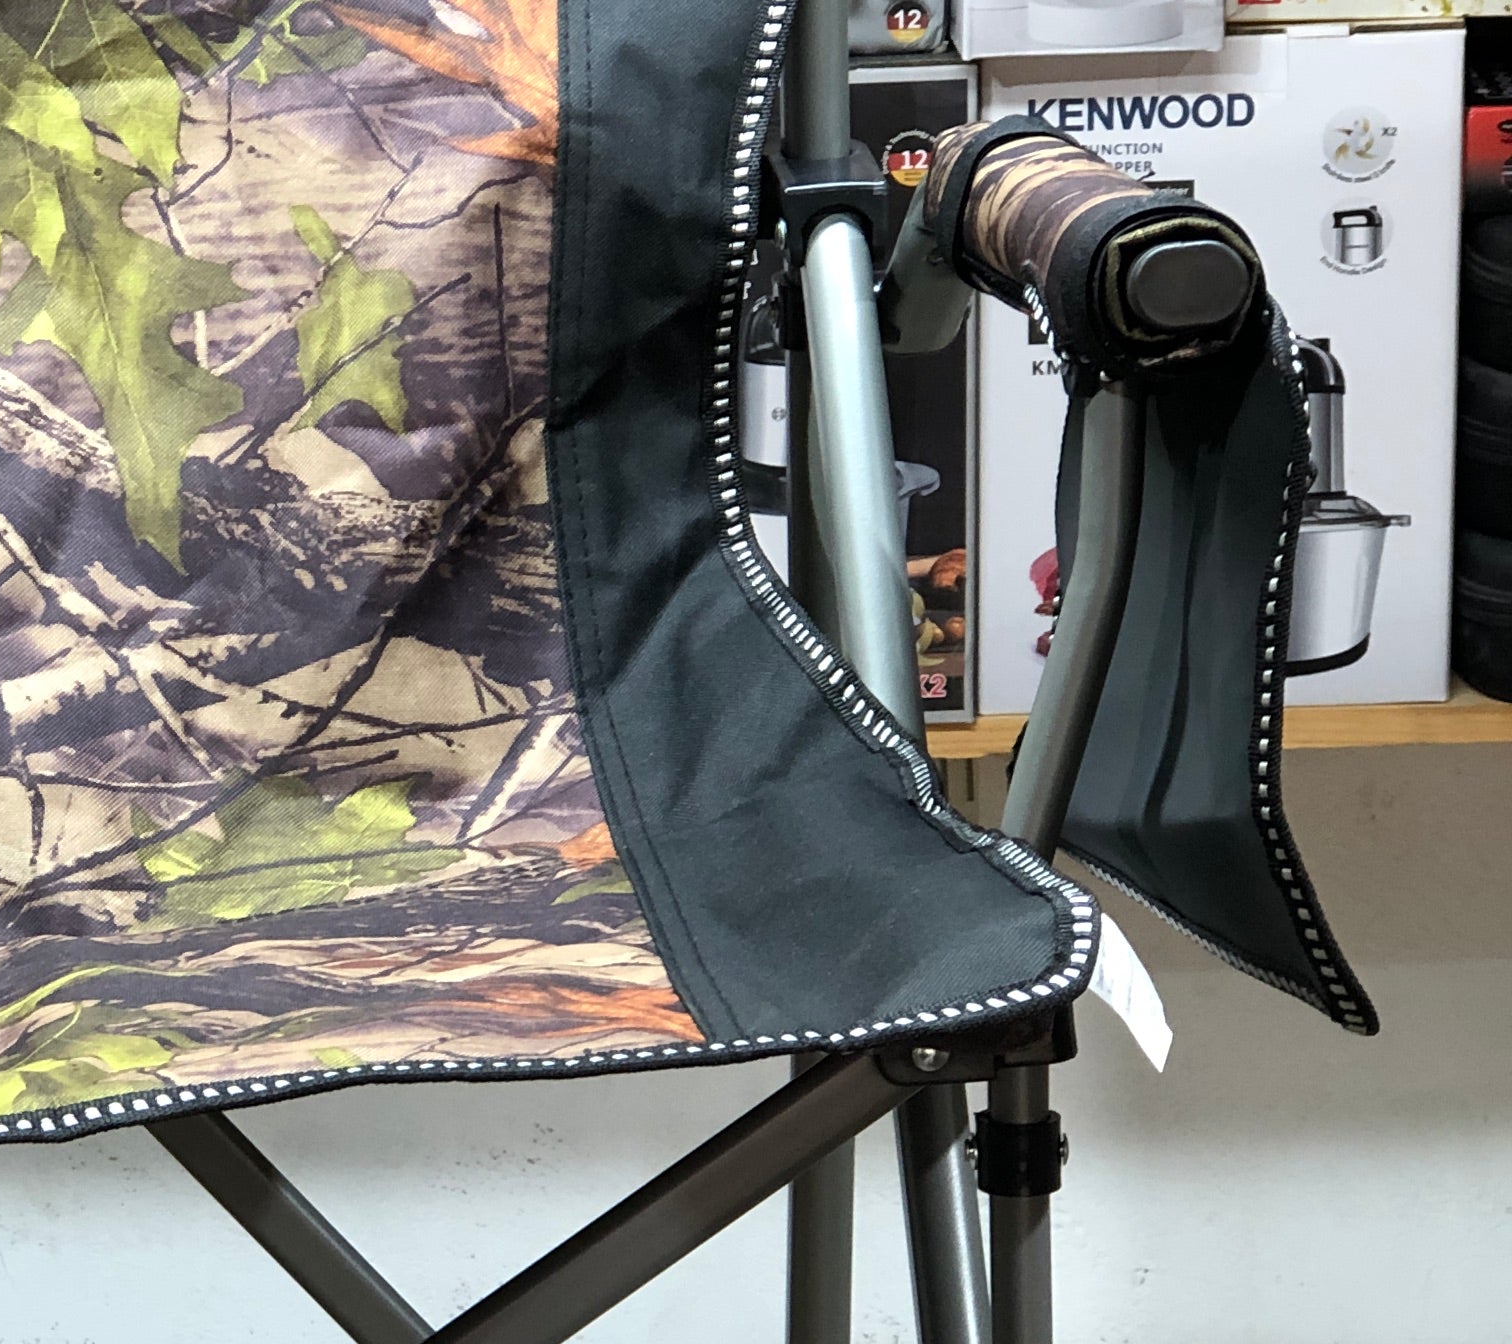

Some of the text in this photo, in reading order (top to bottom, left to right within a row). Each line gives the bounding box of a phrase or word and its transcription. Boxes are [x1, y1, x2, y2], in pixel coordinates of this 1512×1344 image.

[893, 10, 922, 30] 12
[1028, 93, 1255, 132] KENWOOD
[900, 149, 929, 170] 12
[1085, 143, 1163, 156] UNCTION
